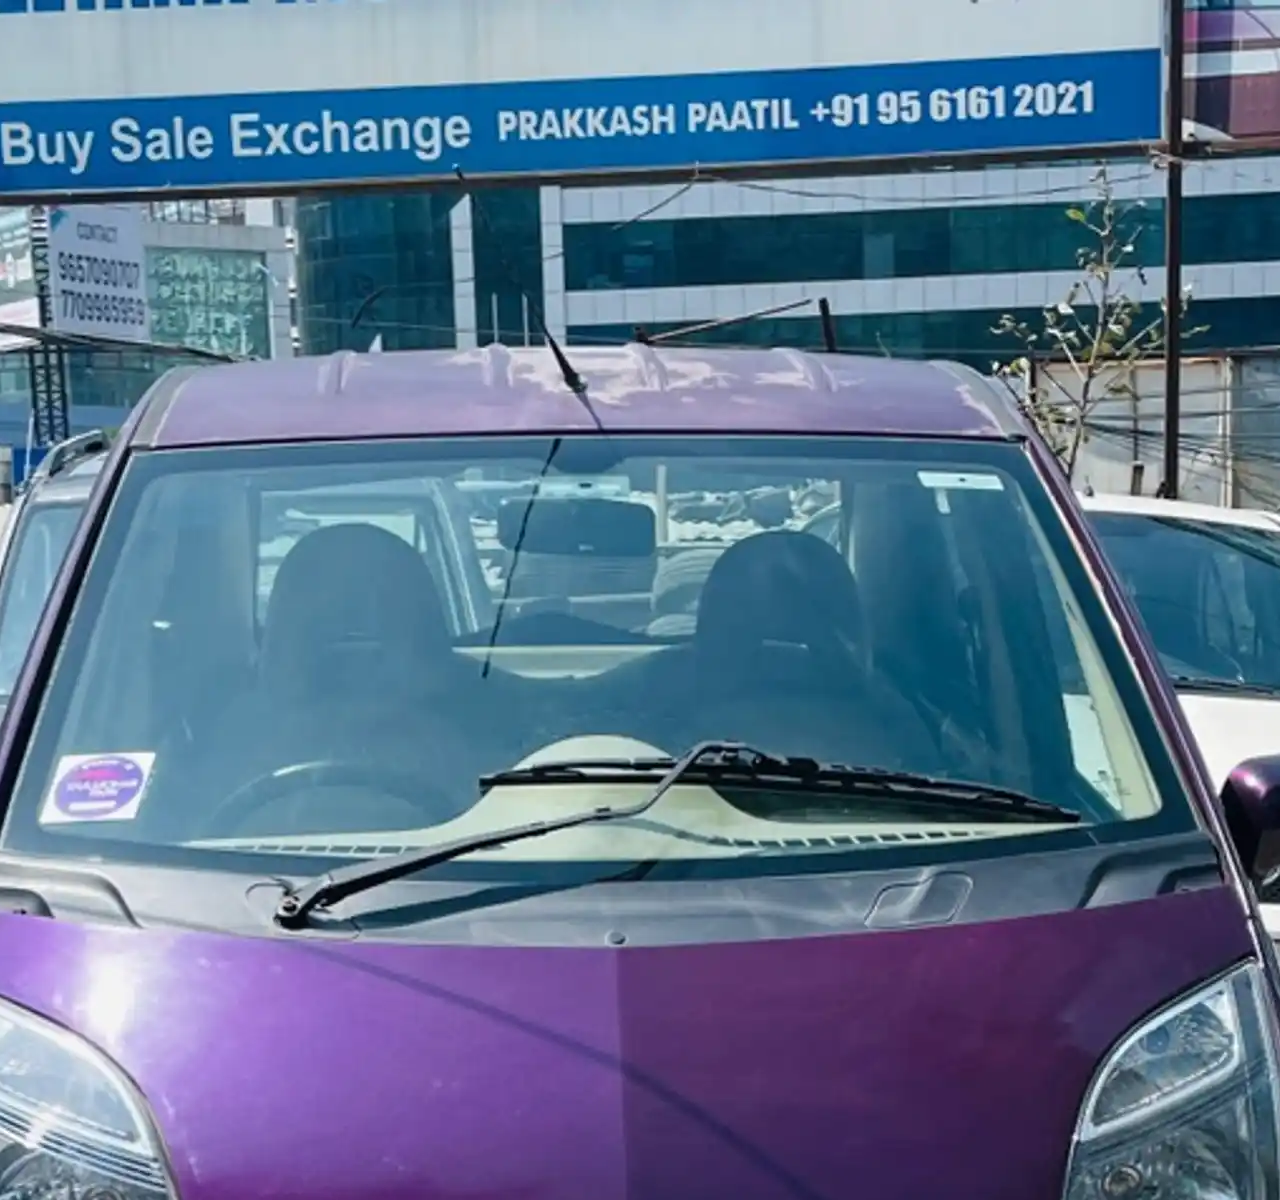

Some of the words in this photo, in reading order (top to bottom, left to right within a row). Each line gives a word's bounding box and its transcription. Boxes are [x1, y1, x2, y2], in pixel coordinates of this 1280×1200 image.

[1, 121, 94, 175] Buy
[111, 115, 214, 163] Sale
[231, 110, 472, 161] Exchange
[497, 104, 676, 142] PRAKKASH
[687, 98, 799, 134] PAATIL
[810, 93, 869, 128] +91
[876, 90, 921, 124] 95
[929, 86, 1006, 120] 6161
[1013, 80, 1095, 117] 2021
